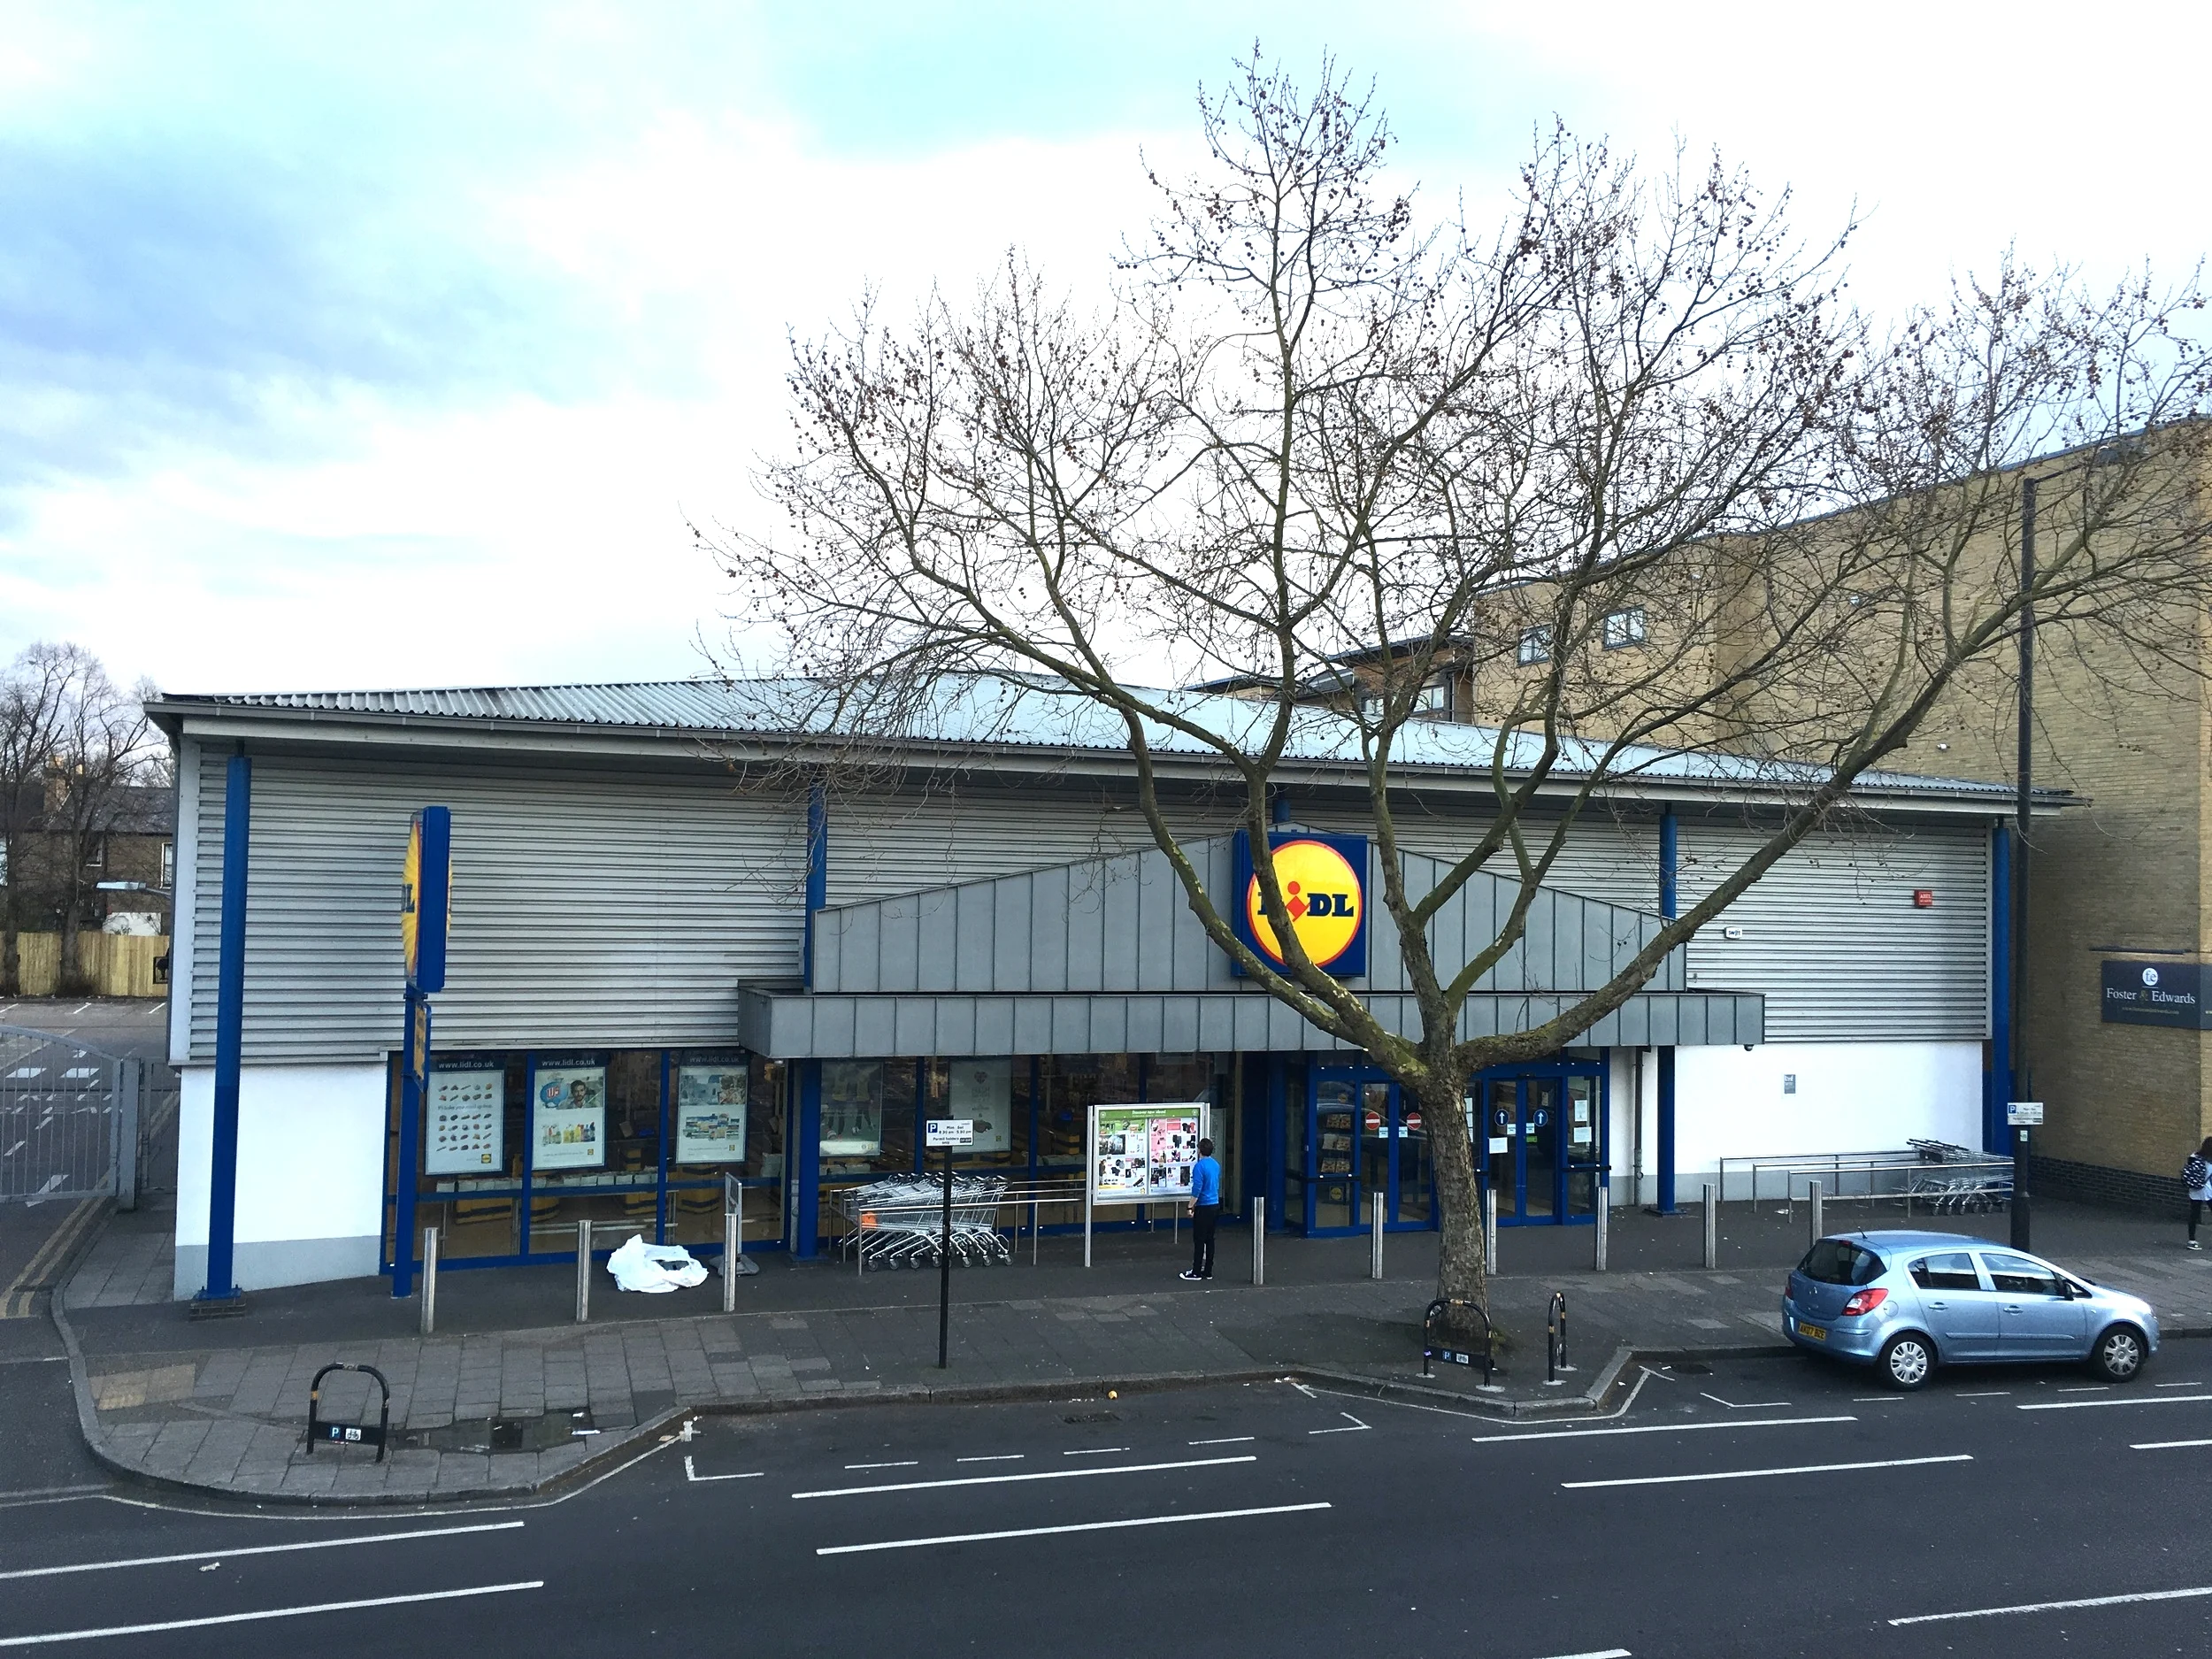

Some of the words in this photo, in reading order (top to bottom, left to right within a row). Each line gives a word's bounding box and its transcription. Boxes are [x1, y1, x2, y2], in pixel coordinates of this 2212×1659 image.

[2106, 987, 2138, 1001] Foster
[2139, 990, 2149, 1001] &
[2151, 990, 2196, 1004] Edwards
[930, 1124, 937, 1133] P
[332, 1427, 339, 1438] P
